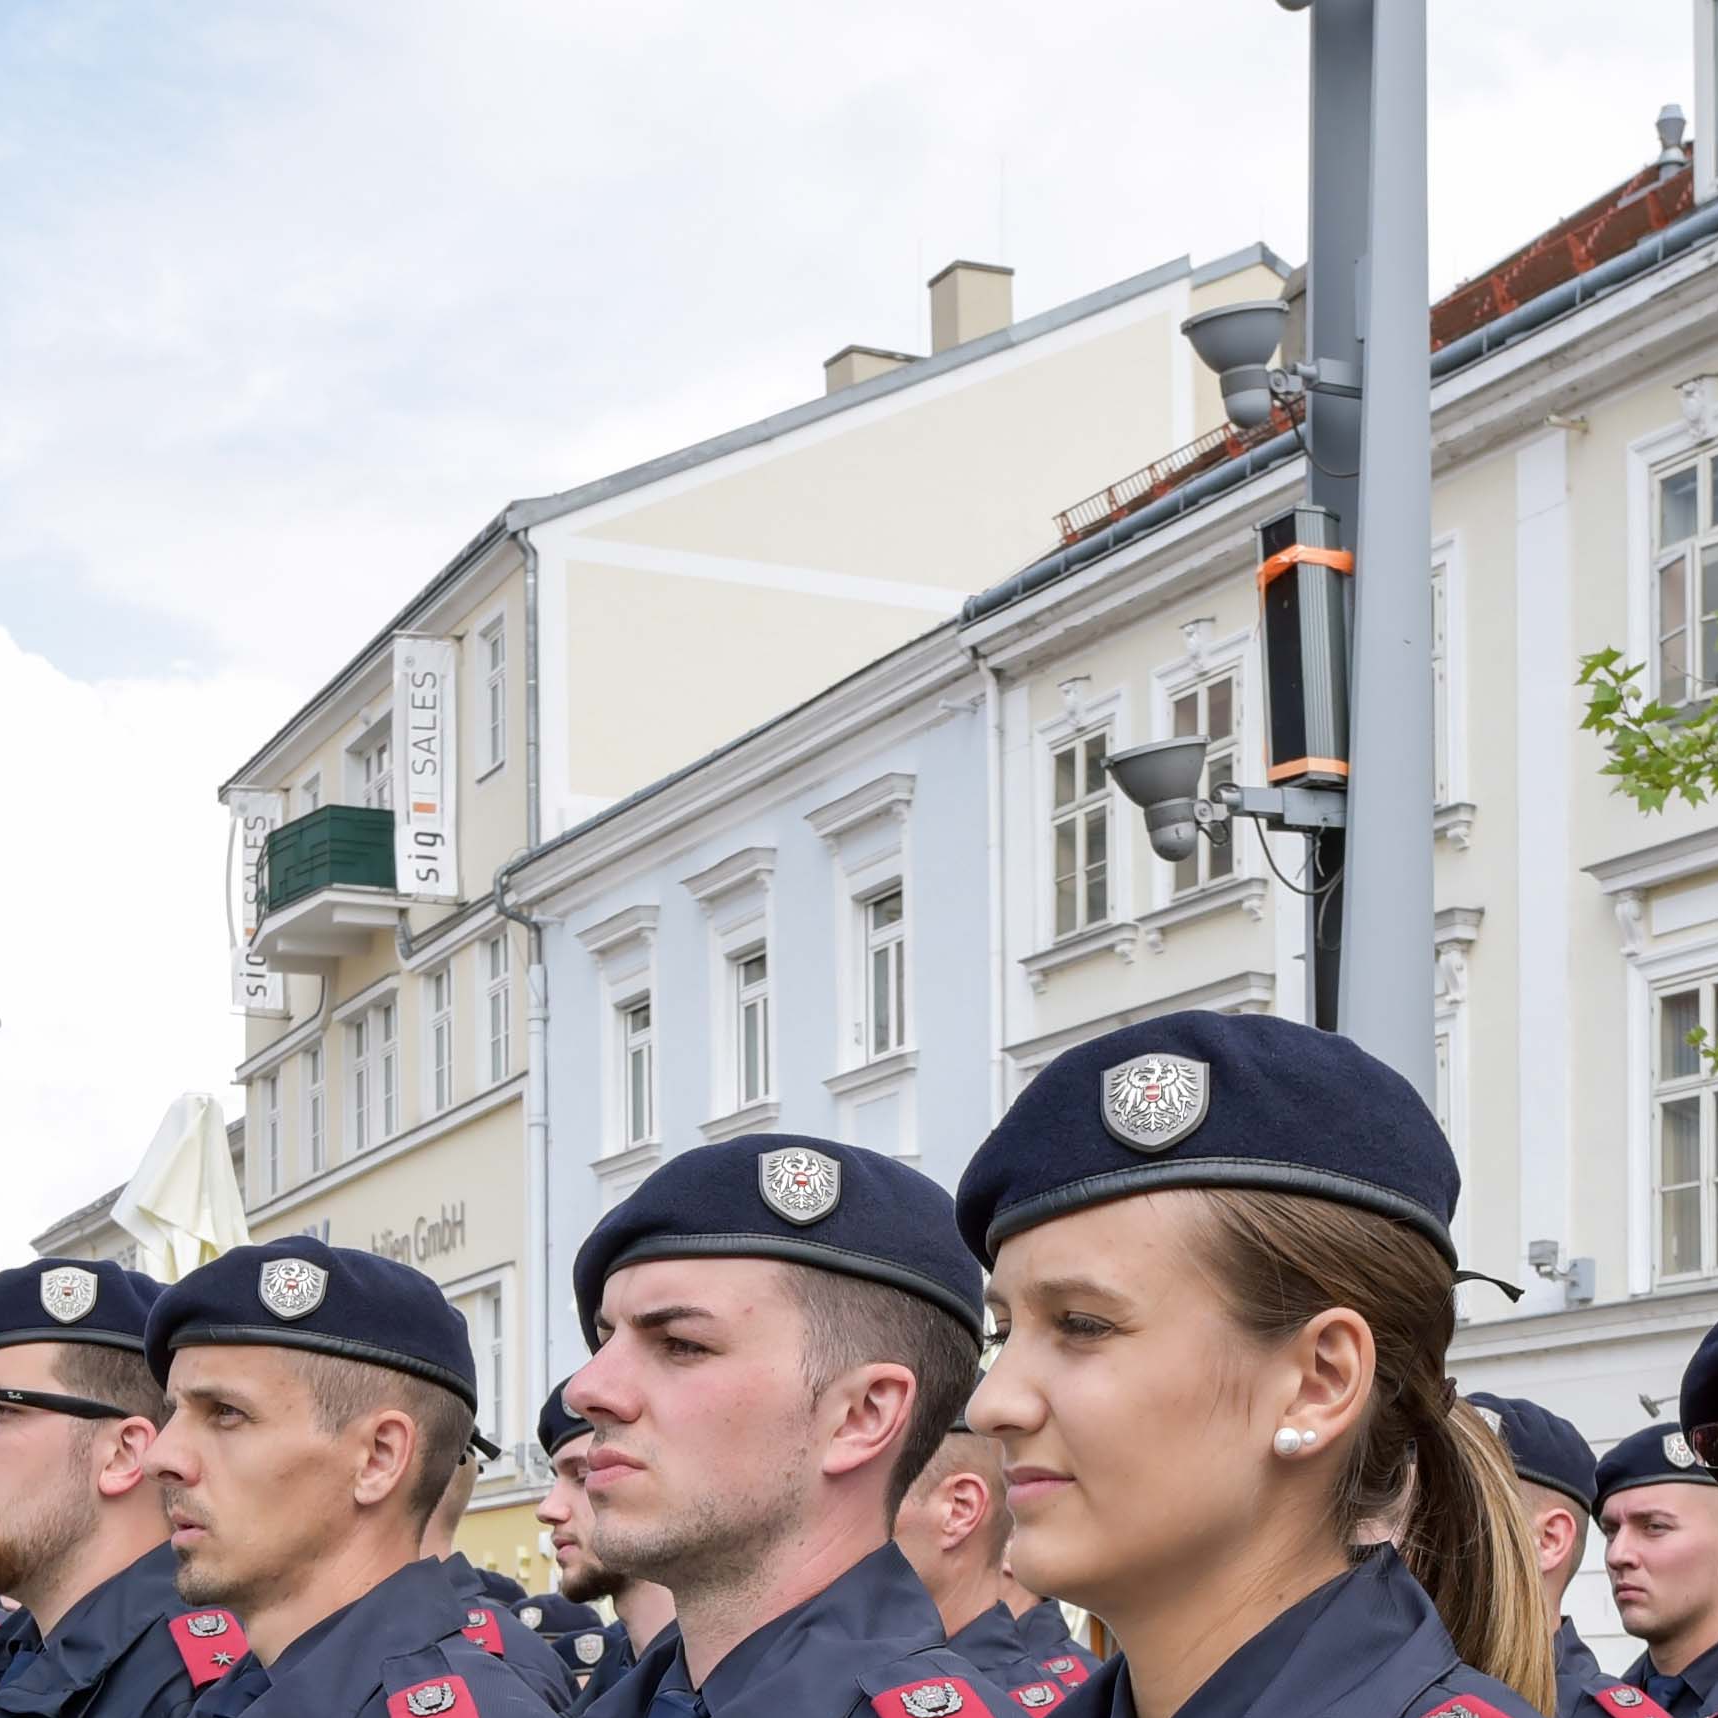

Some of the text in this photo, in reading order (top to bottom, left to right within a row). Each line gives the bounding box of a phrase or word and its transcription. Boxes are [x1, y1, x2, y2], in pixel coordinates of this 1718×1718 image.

[407, 671, 445, 883] sig SALES
[414, 1199, 466, 1262] GmbH
